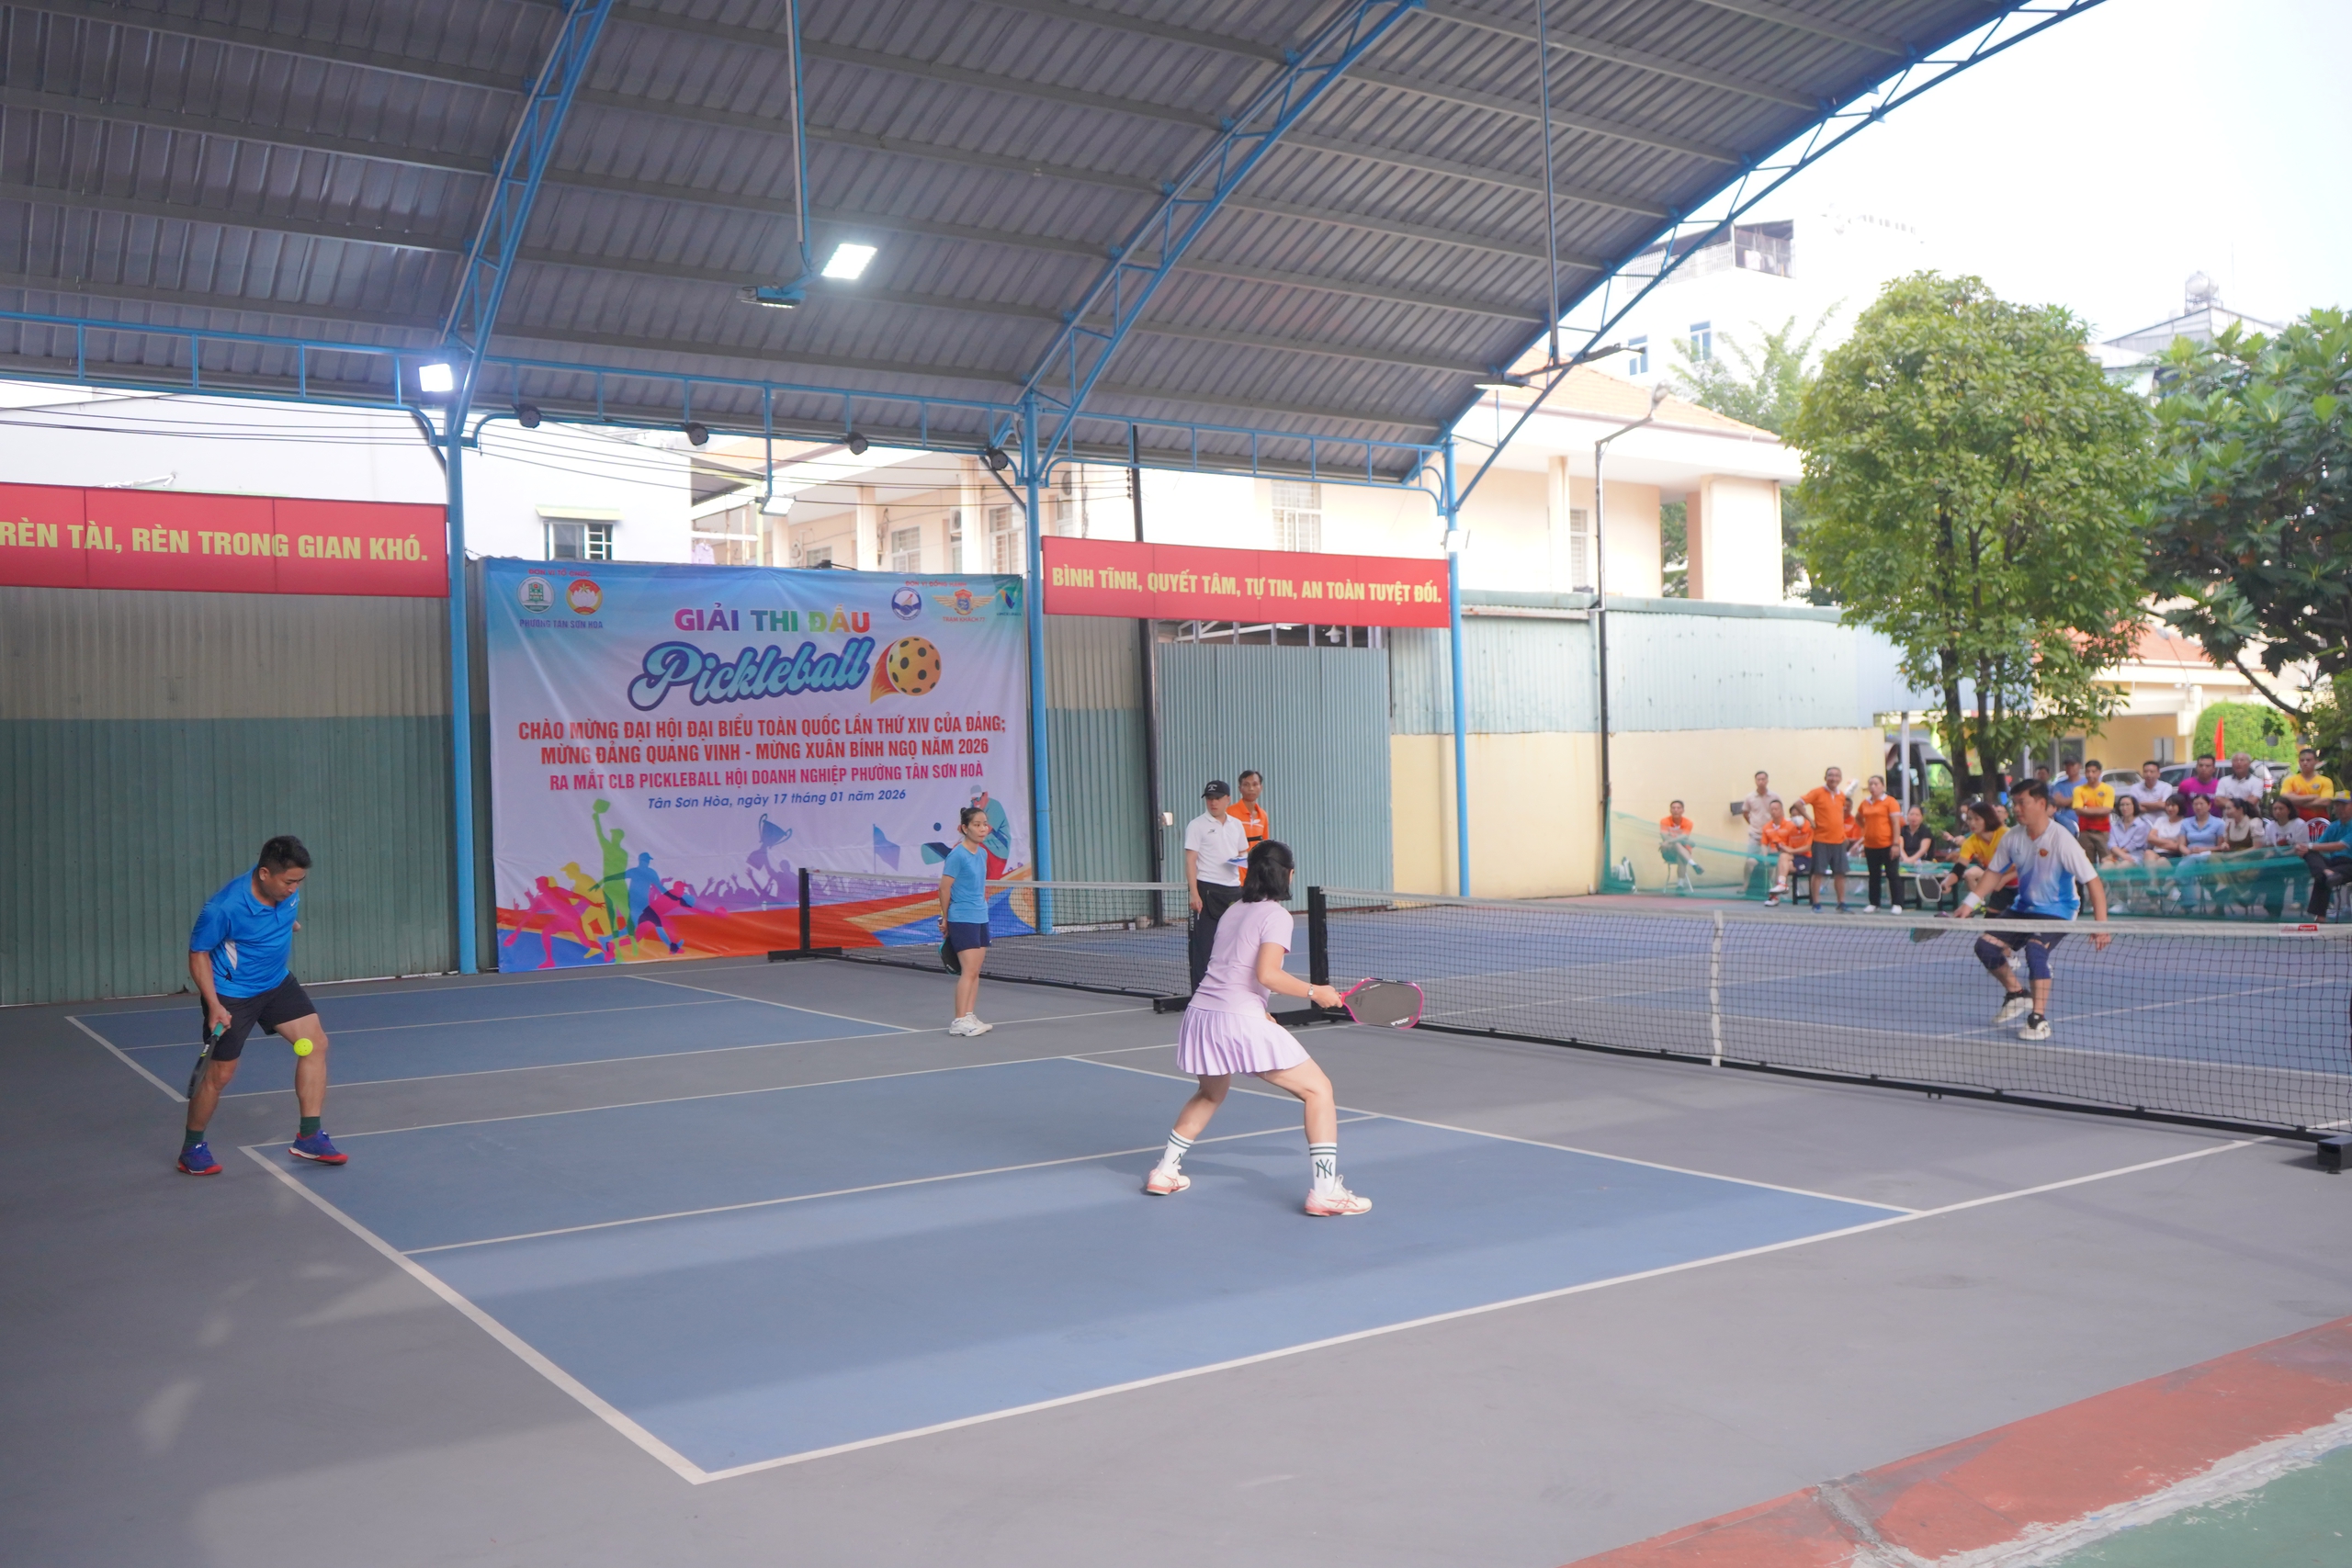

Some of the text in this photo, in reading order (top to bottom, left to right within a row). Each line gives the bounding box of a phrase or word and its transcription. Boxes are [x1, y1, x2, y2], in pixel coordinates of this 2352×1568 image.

[0, 517, 428, 561] RÈN TÀI, RÈN TRONG GIAN KHÓ.
[1052, 564, 1442, 605] BÌNH TĨNH, QUYẾT TÂM, TỰ TIN, AN TOÀN TUYỆT ĐỐI.
[673, 603, 871, 634] GIẢI THI ĐẤU
[628, 637, 876, 711] Pickleball
[518, 711, 1006, 742] CHÀO MỪNG ĐẠI HỘI ĐẠI BIỂU TOÀN QUỐC LẦN THỨ XIV CỦA ĐẢNG;
[541, 743, 591, 764] MỪNG
[596, 740, 640, 763] ĐẢNG
[646, 745, 699, 764] QUANG
[704, 744, 741, 761] VINH
[756, 740, 800, 760] MỪNG
[806, 739, 845, 759] XUÂN
[850, 739, 884, 758] BÍNH
[888, 740, 918, 760] NGỌ
[922, 737, 955, 756] NĂM
[958, 739, 989, 755] 2026
[549, 760, 983, 791] RA MẮT CLB PICKLEBALL HỘI DOANH NGHIỆP PHƯỜNG TÂN SƠN HOÀ
[648, 790, 906, 809] Tân Sơn Hòa, ngày 17 tháng 01 năm 2026
